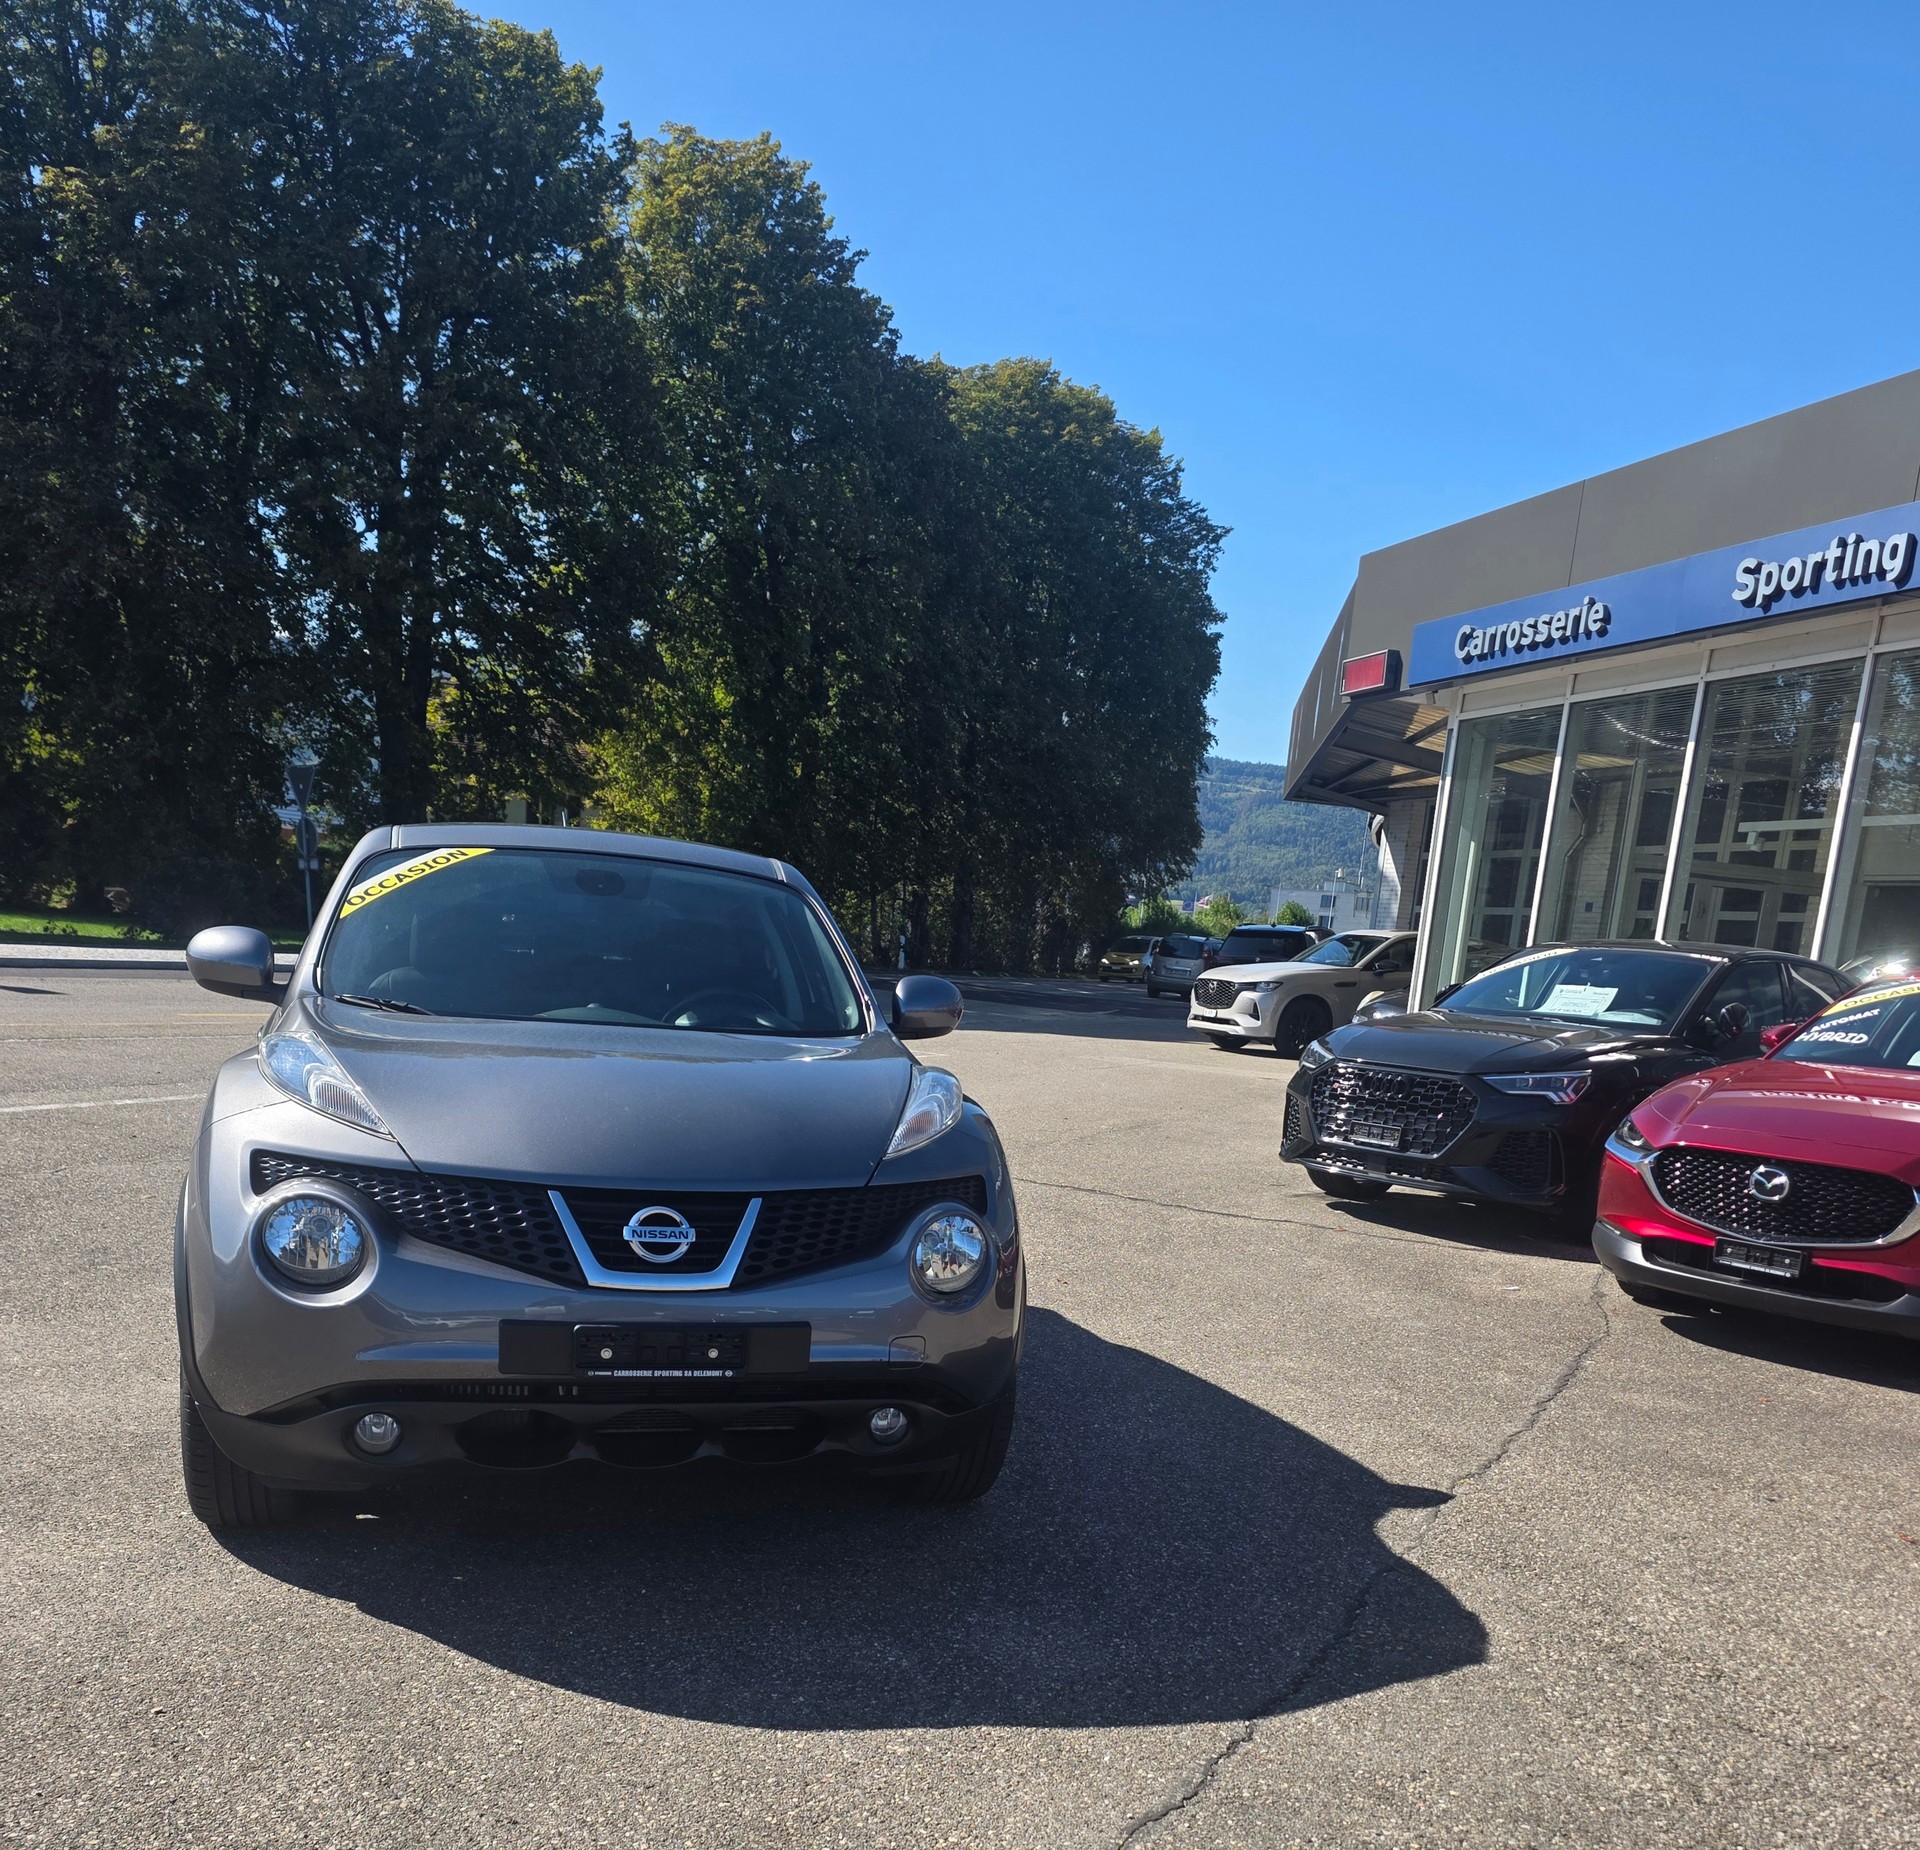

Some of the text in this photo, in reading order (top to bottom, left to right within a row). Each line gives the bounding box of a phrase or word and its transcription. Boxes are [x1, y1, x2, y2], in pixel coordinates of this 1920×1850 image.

[1455, 532, 1910, 660] Carrosserie Sporting
[346, 849, 469, 907] OCCASION
[1810, 1008, 1881, 1033] AUTOMAT
[1794, 1031, 1869, 1045] HYBRID
[631, 1229, 690, 1240] NISSAN
[613, 1369, 653, 1377] CARROSSERIE
[653, 1369, 683, 1377] SPORTING
[683, 1369, 693, 1377] SA
